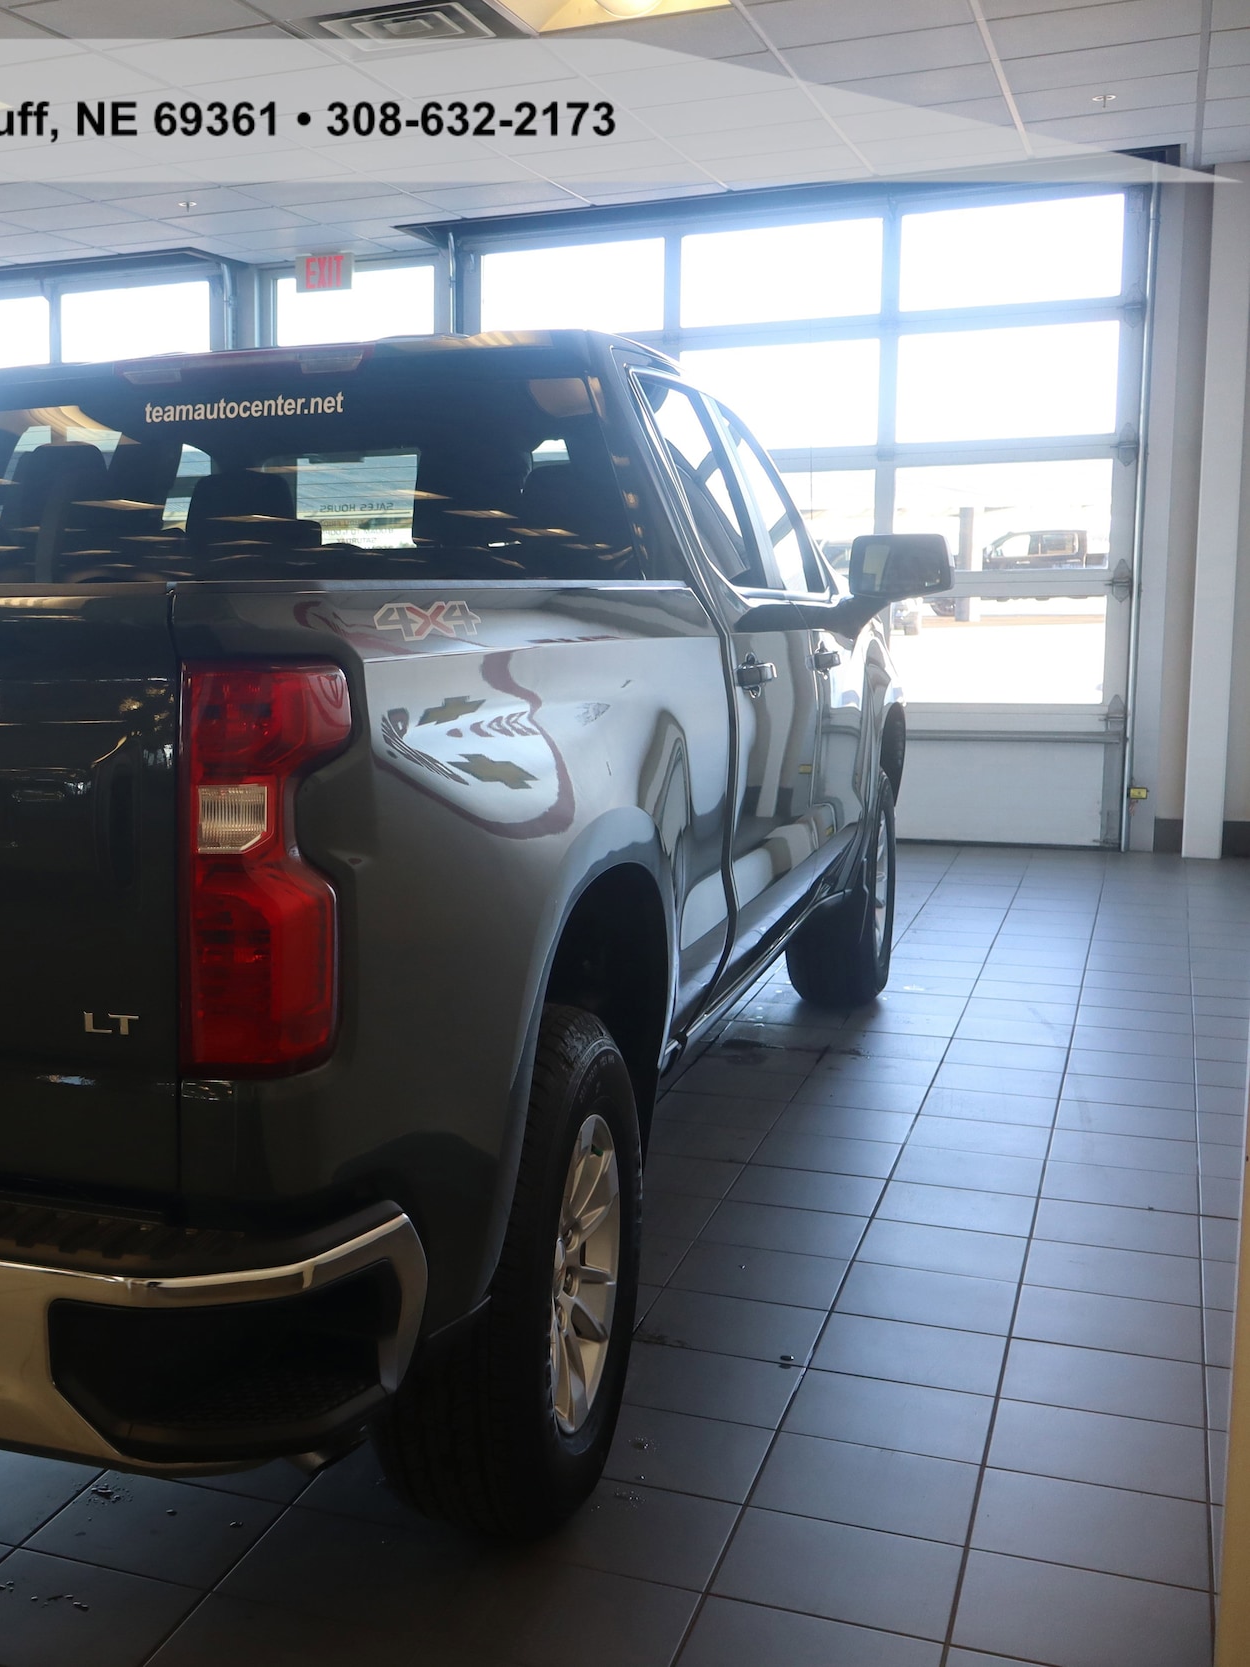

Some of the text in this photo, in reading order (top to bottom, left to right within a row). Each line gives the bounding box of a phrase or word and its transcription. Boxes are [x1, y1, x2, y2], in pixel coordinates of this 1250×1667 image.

[305, 255, 344, 289] EXIT
[145, 392, 344, 424] teamautocenter.net
[83, 1011, 139, 1035] LT
